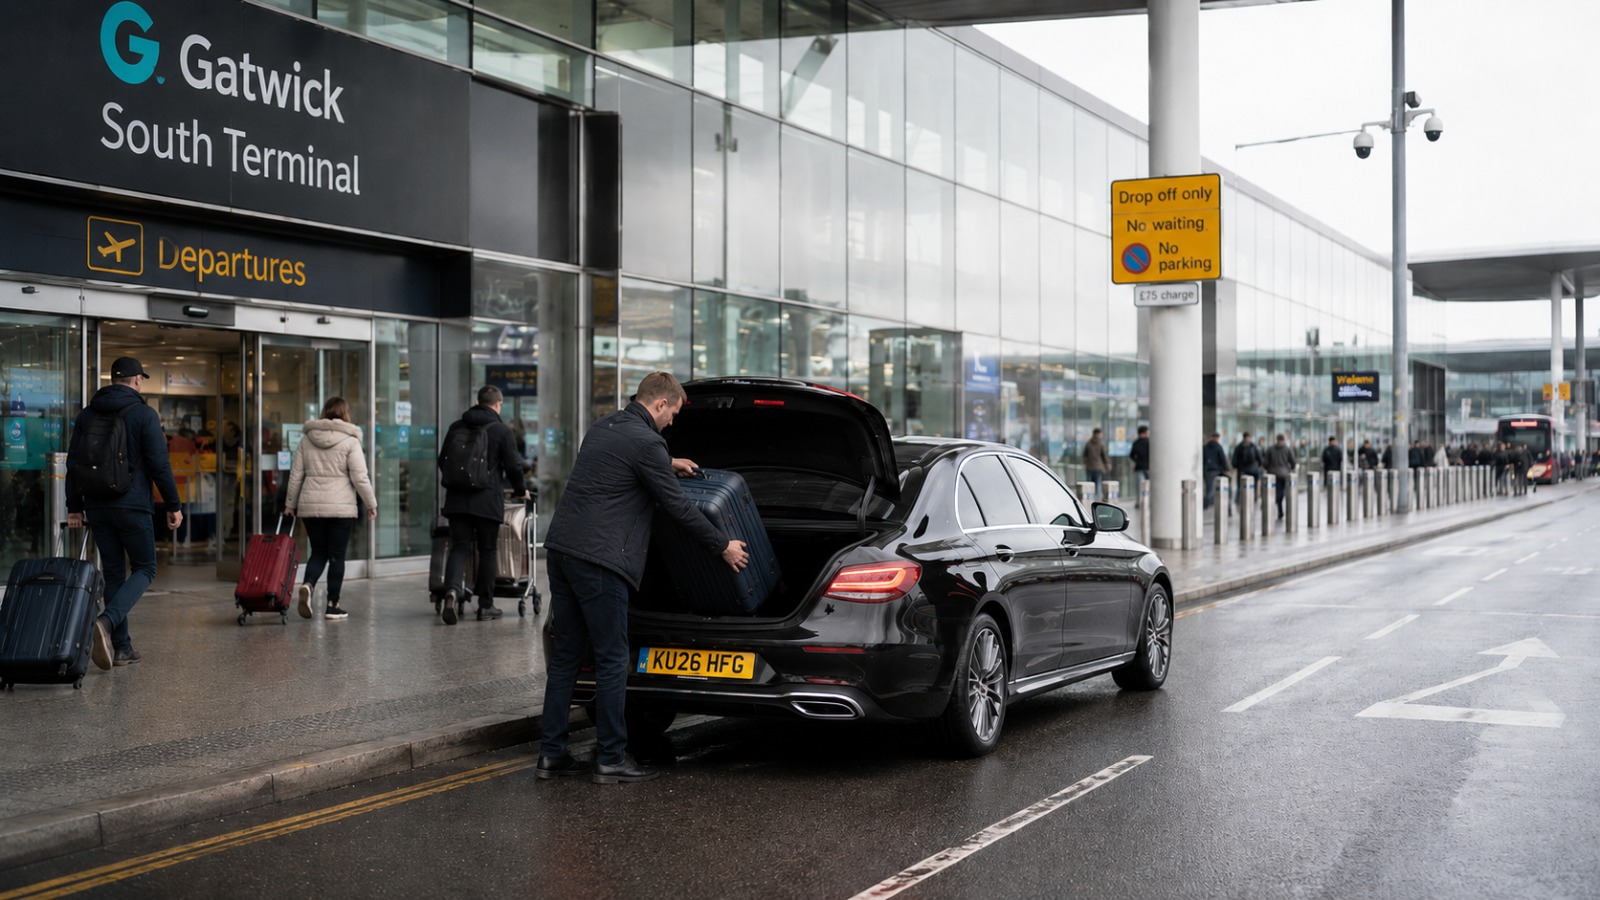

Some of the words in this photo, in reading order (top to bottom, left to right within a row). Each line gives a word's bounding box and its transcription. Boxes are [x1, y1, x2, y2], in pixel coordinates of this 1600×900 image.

[179, 34, 345, 124] Gatwick
[100, 101, 213, 167] South
[223, 127, 360, 196] Terminal
[1119, 190, 1153, 205] Drop
[1158, 187, 1177, 201] off
[1182, 186, 1212, 202] only
[1127, 219, 1147, 232] No
[1152, 217, 1204, 232] waiting
[1159, 242, 1179, 255] No
[158, 236, 306, 287] Departures
[1159, 257, 1212, 274] parking
[1139, 290, 1158, 301] £75
[1161, 289, 1194, 302] charge
[652, 650, 702, 672] KU26
[706, 653, 745, 674] HFG
